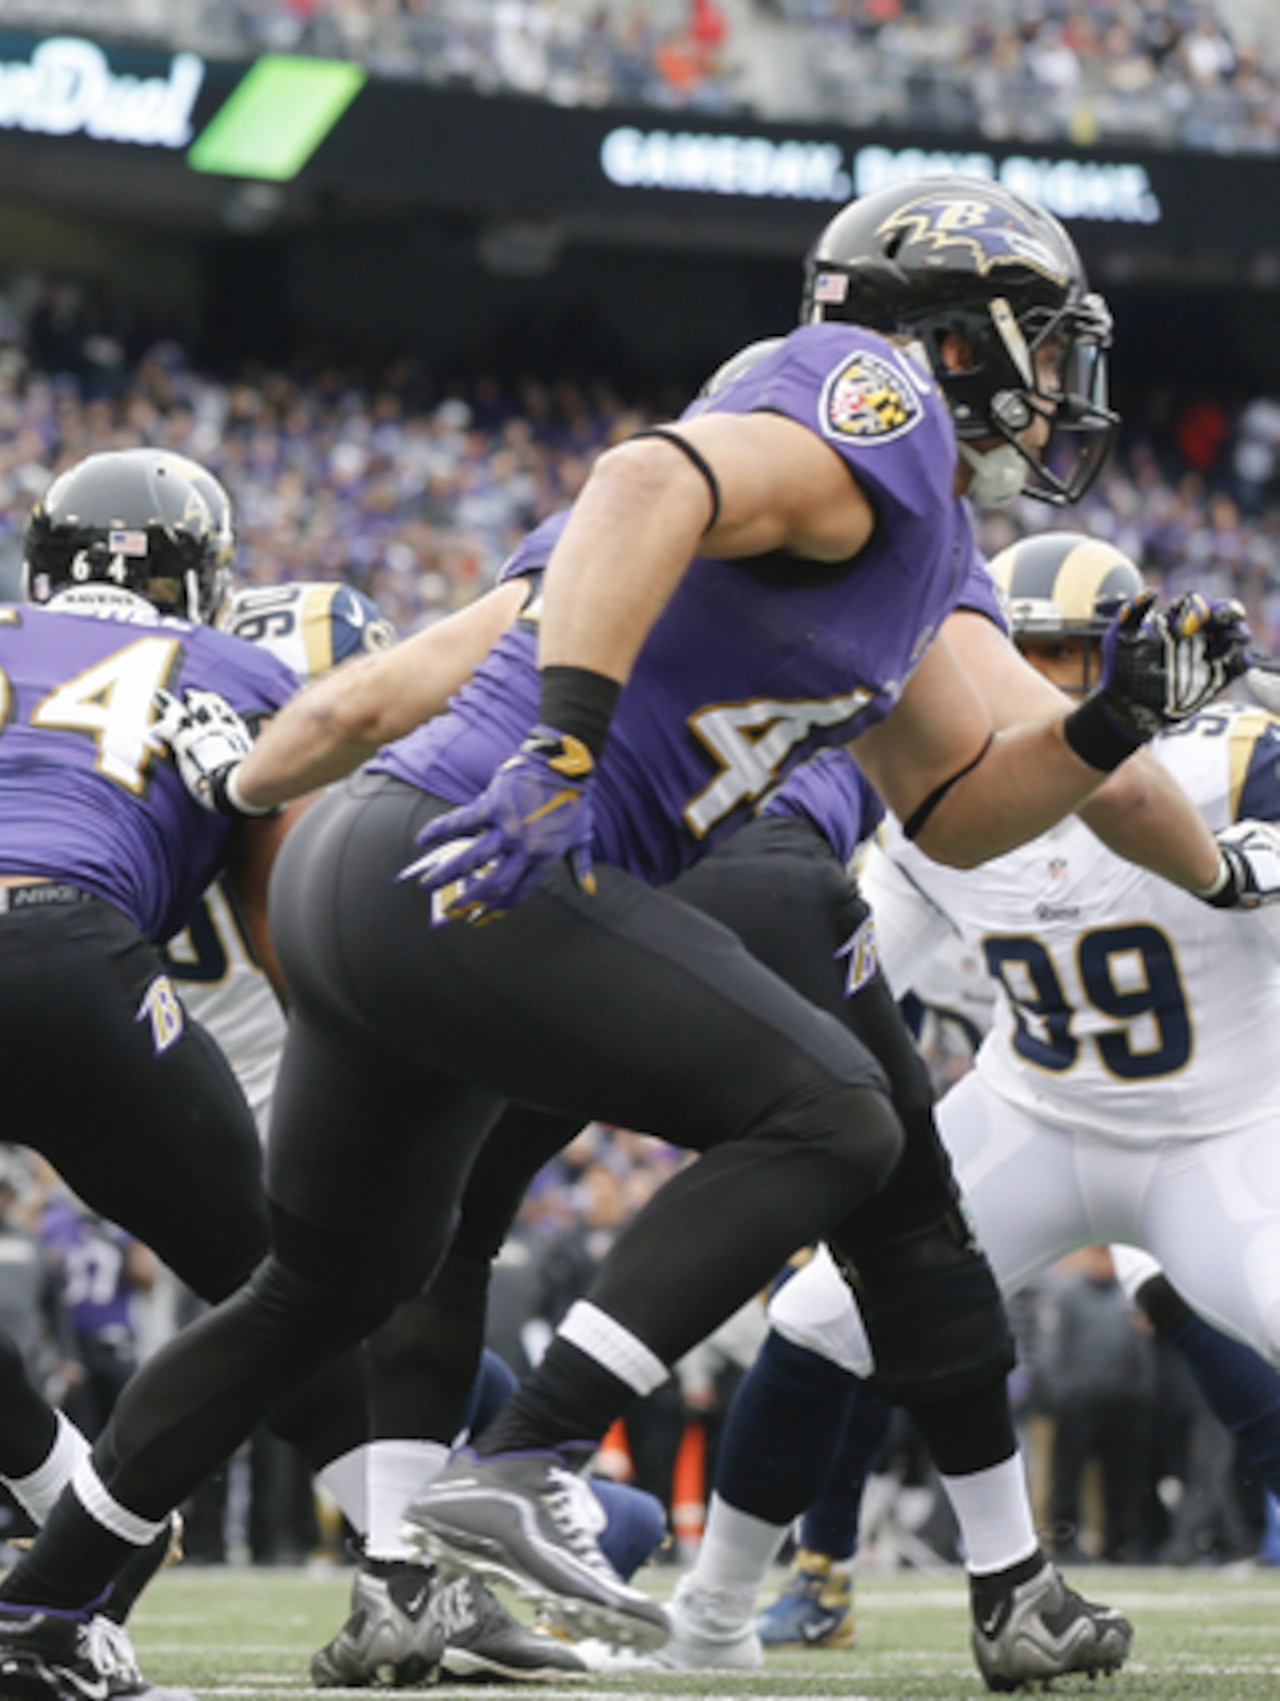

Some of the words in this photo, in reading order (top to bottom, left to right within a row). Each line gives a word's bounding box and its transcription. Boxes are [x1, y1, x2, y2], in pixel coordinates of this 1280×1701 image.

[70, 550, 127, 584] 64
[683, 685, 872, 840] 4
[981, 921, 1193, 1082] 99
